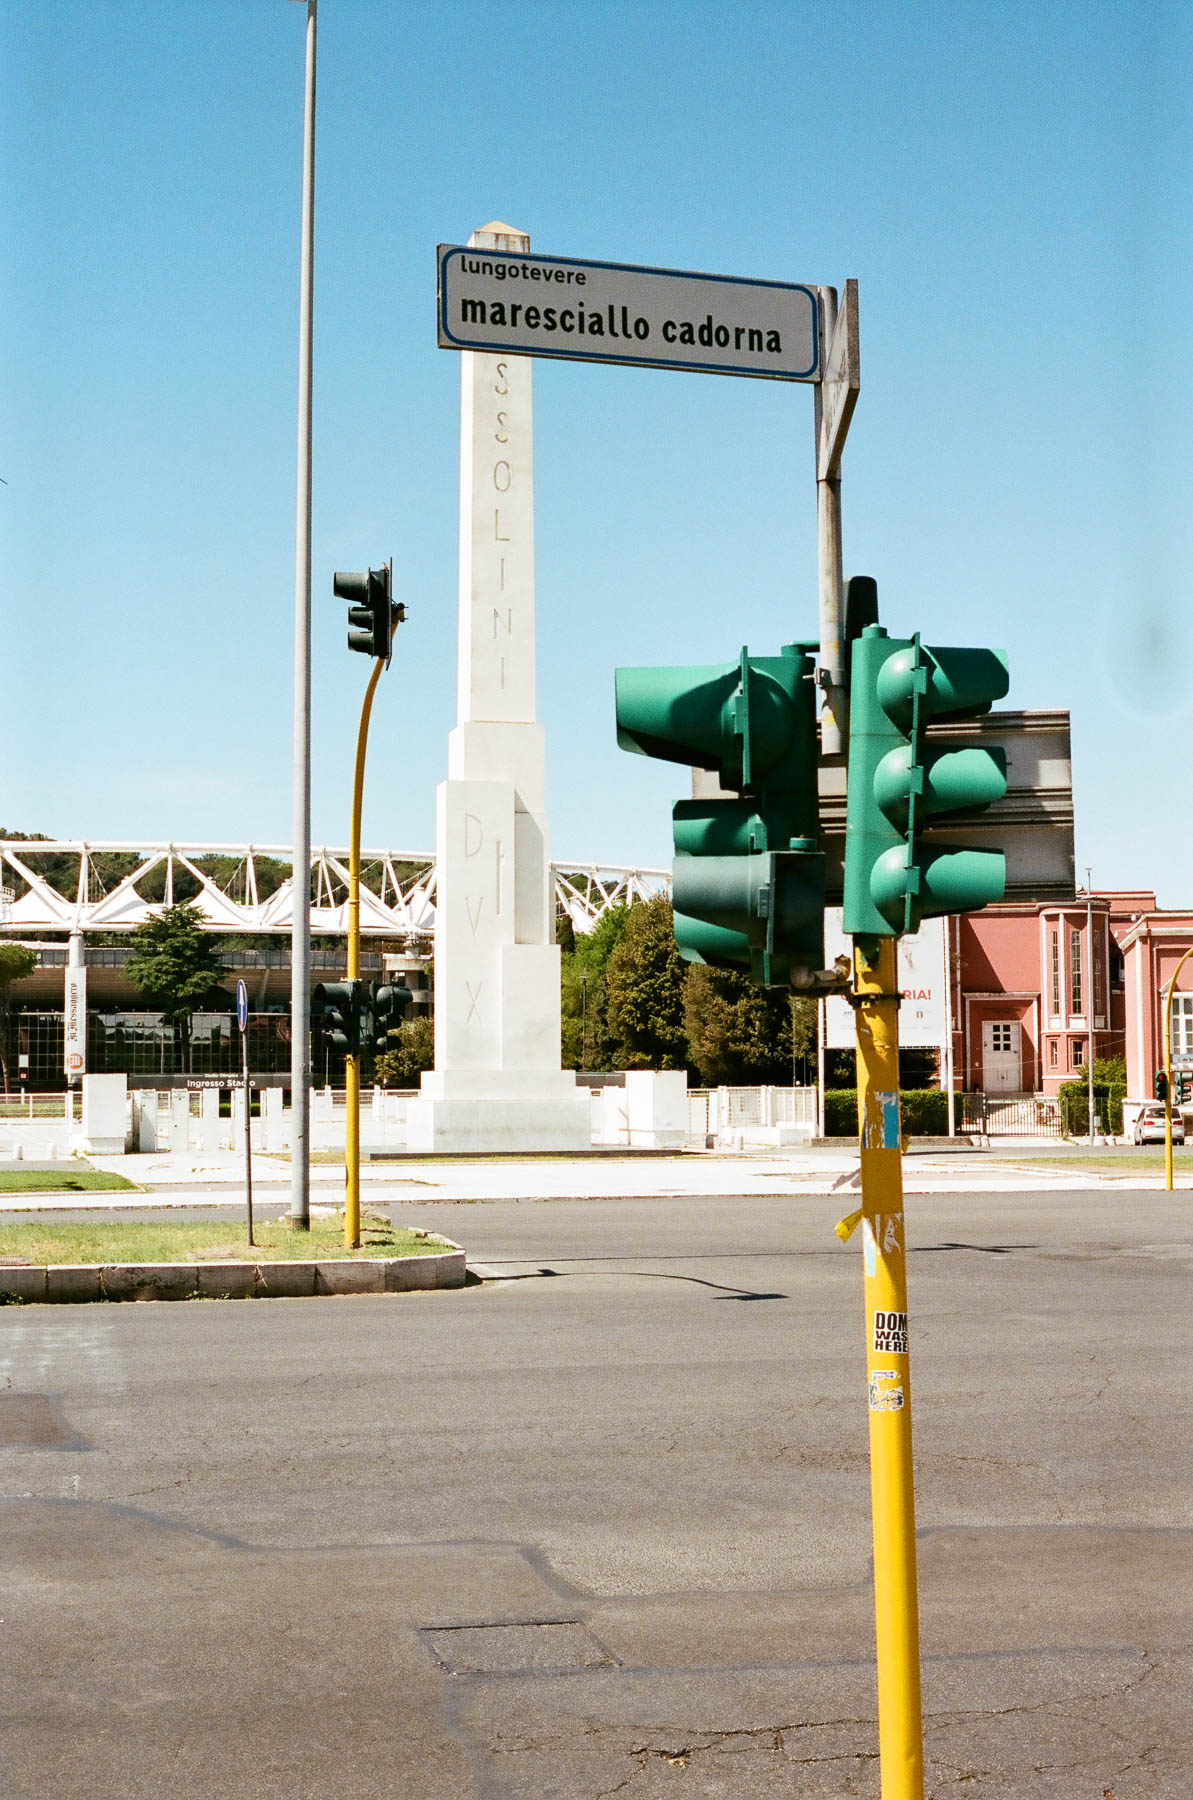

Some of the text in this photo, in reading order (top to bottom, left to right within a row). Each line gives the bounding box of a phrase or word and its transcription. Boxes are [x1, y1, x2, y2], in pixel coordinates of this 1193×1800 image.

[460, 255, 587, 286] lungotevere
[460, 297, 783, 354] maresciallo cadorna
[492, 361, 513, 690] SSOLINI
[903, 989, 931, 1000] RIA!
[187, 1079, 256, 1089] Ingresso Stado
[875, 1330, 908, 1341] WAS
[875, 1340, 907, 1352] HERE
